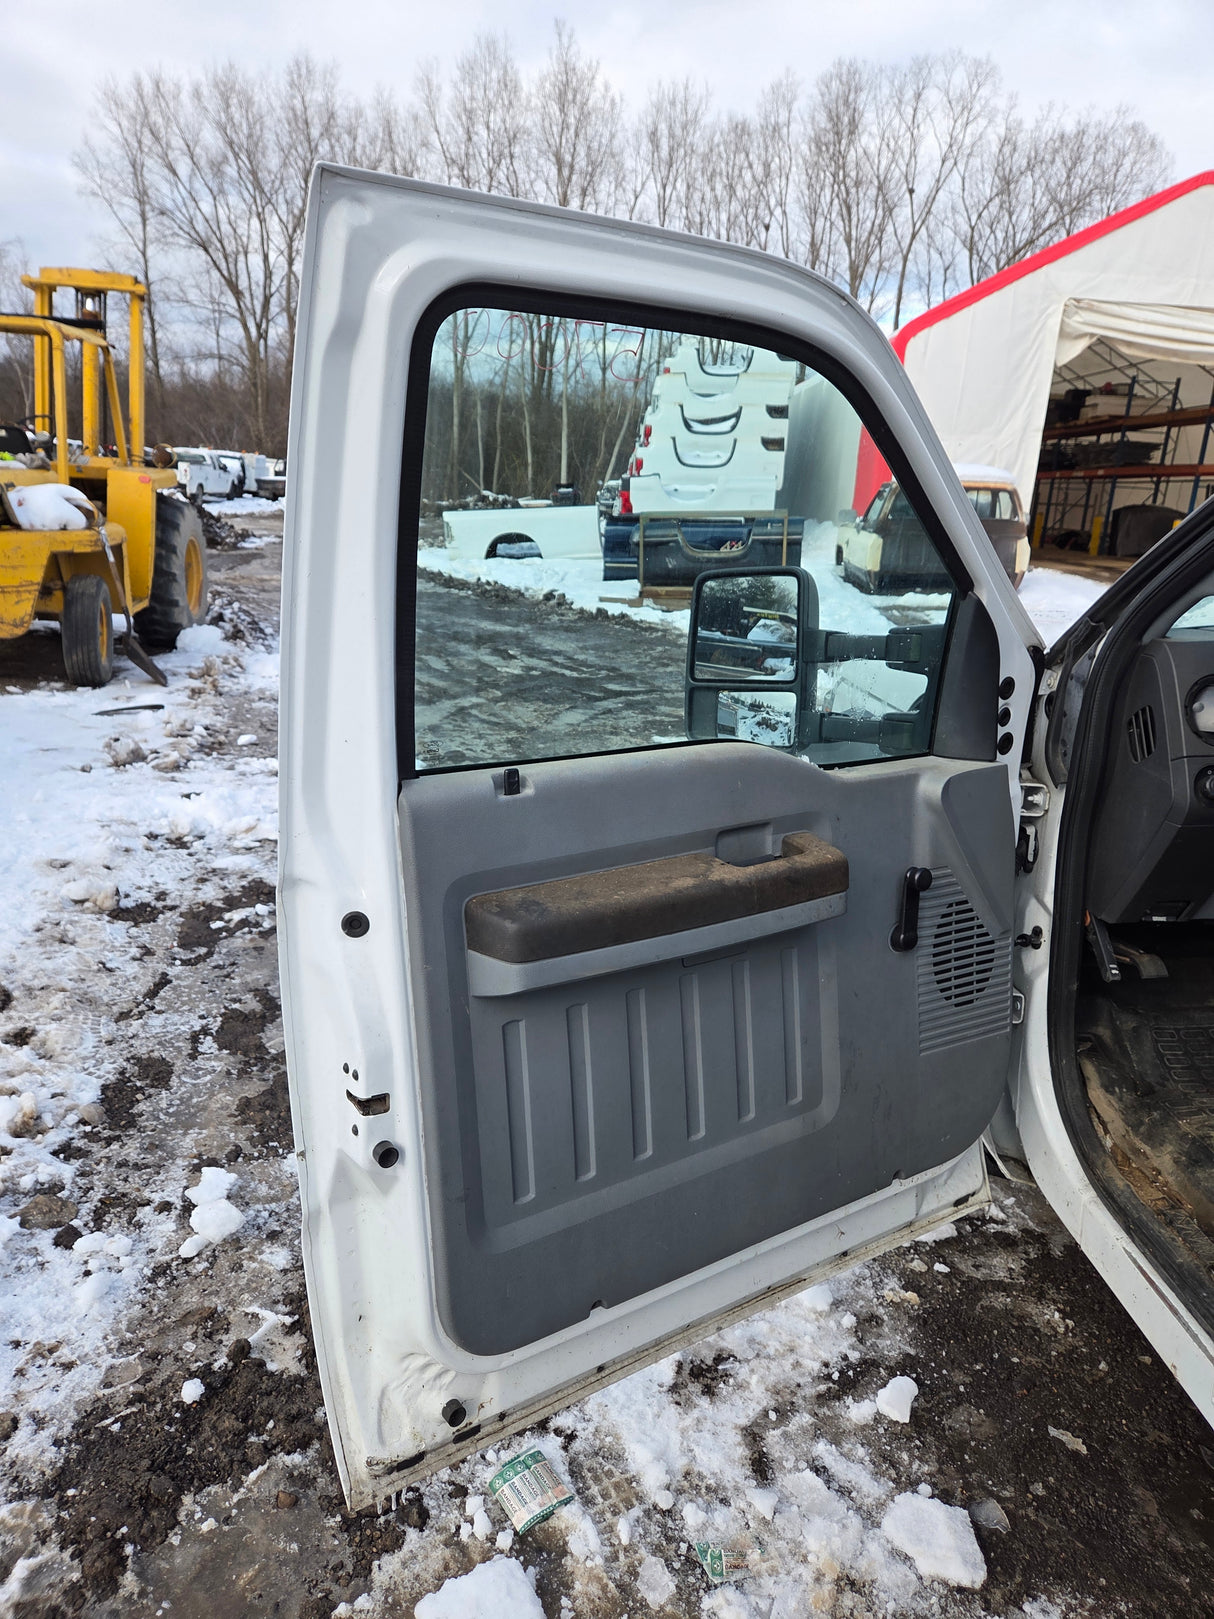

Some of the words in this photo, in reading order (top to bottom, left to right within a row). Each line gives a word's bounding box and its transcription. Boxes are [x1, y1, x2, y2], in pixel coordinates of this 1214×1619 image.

[522, 1473, 539, 1497] BANDAGE
[534, 1466, 552, 1489] BANDAGE
[501, 1489, 518, 1513] BANDAGE
[511, 1481, 528, 1505] BANDAGE
